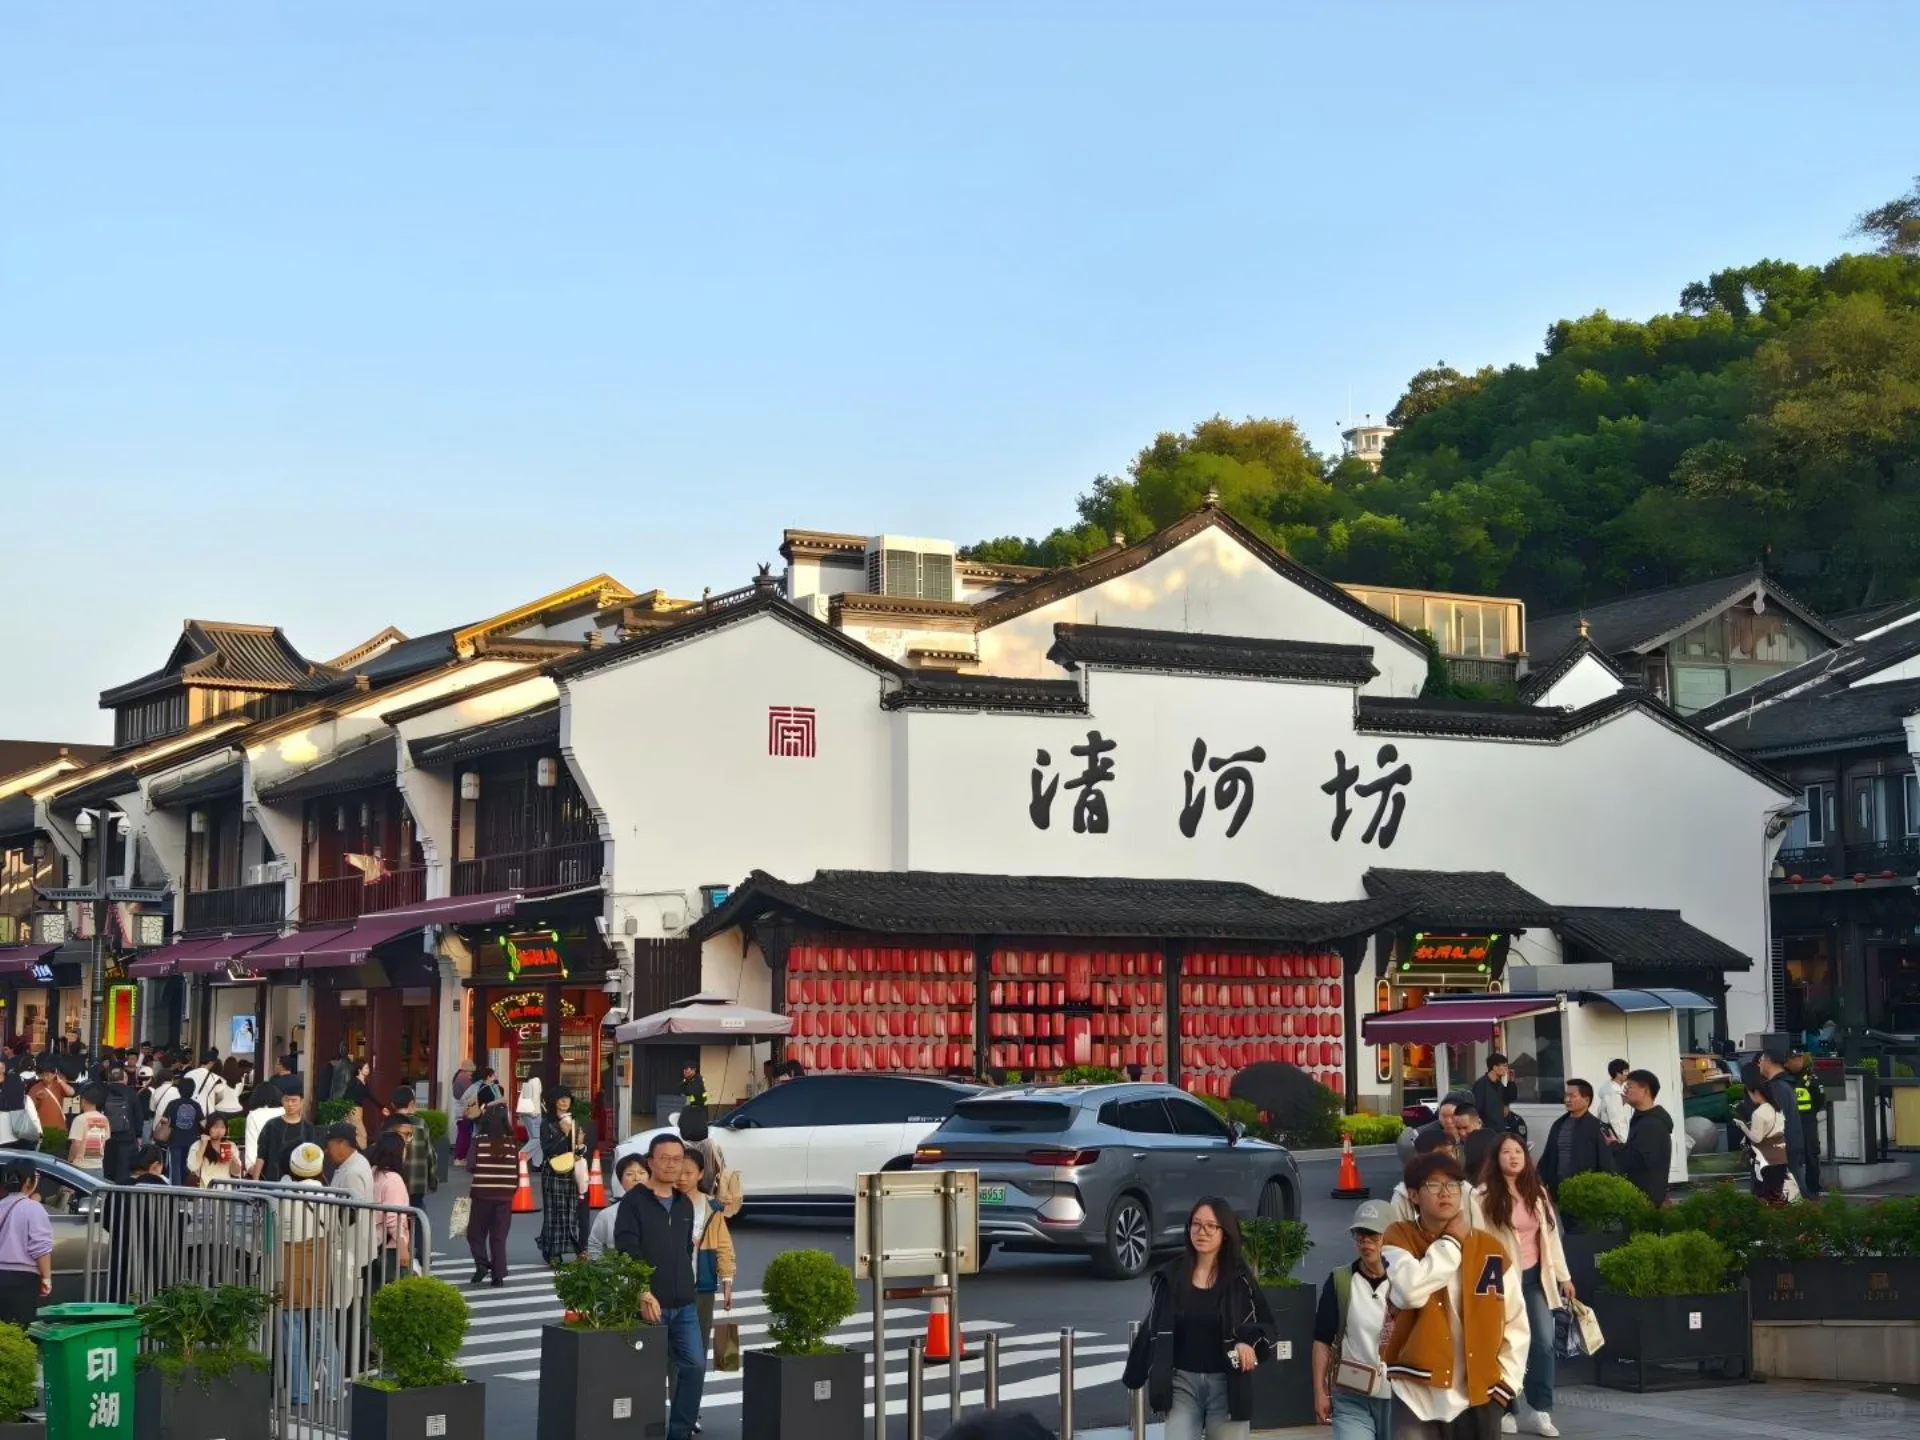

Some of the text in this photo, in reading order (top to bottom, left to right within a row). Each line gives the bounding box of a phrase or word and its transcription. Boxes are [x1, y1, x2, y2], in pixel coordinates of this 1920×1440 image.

[1029, 730, 1412, 849] 清河坊
[1475, 1254, 1504, 1296] A
[86, 1347, 120, 1428] 印湖
